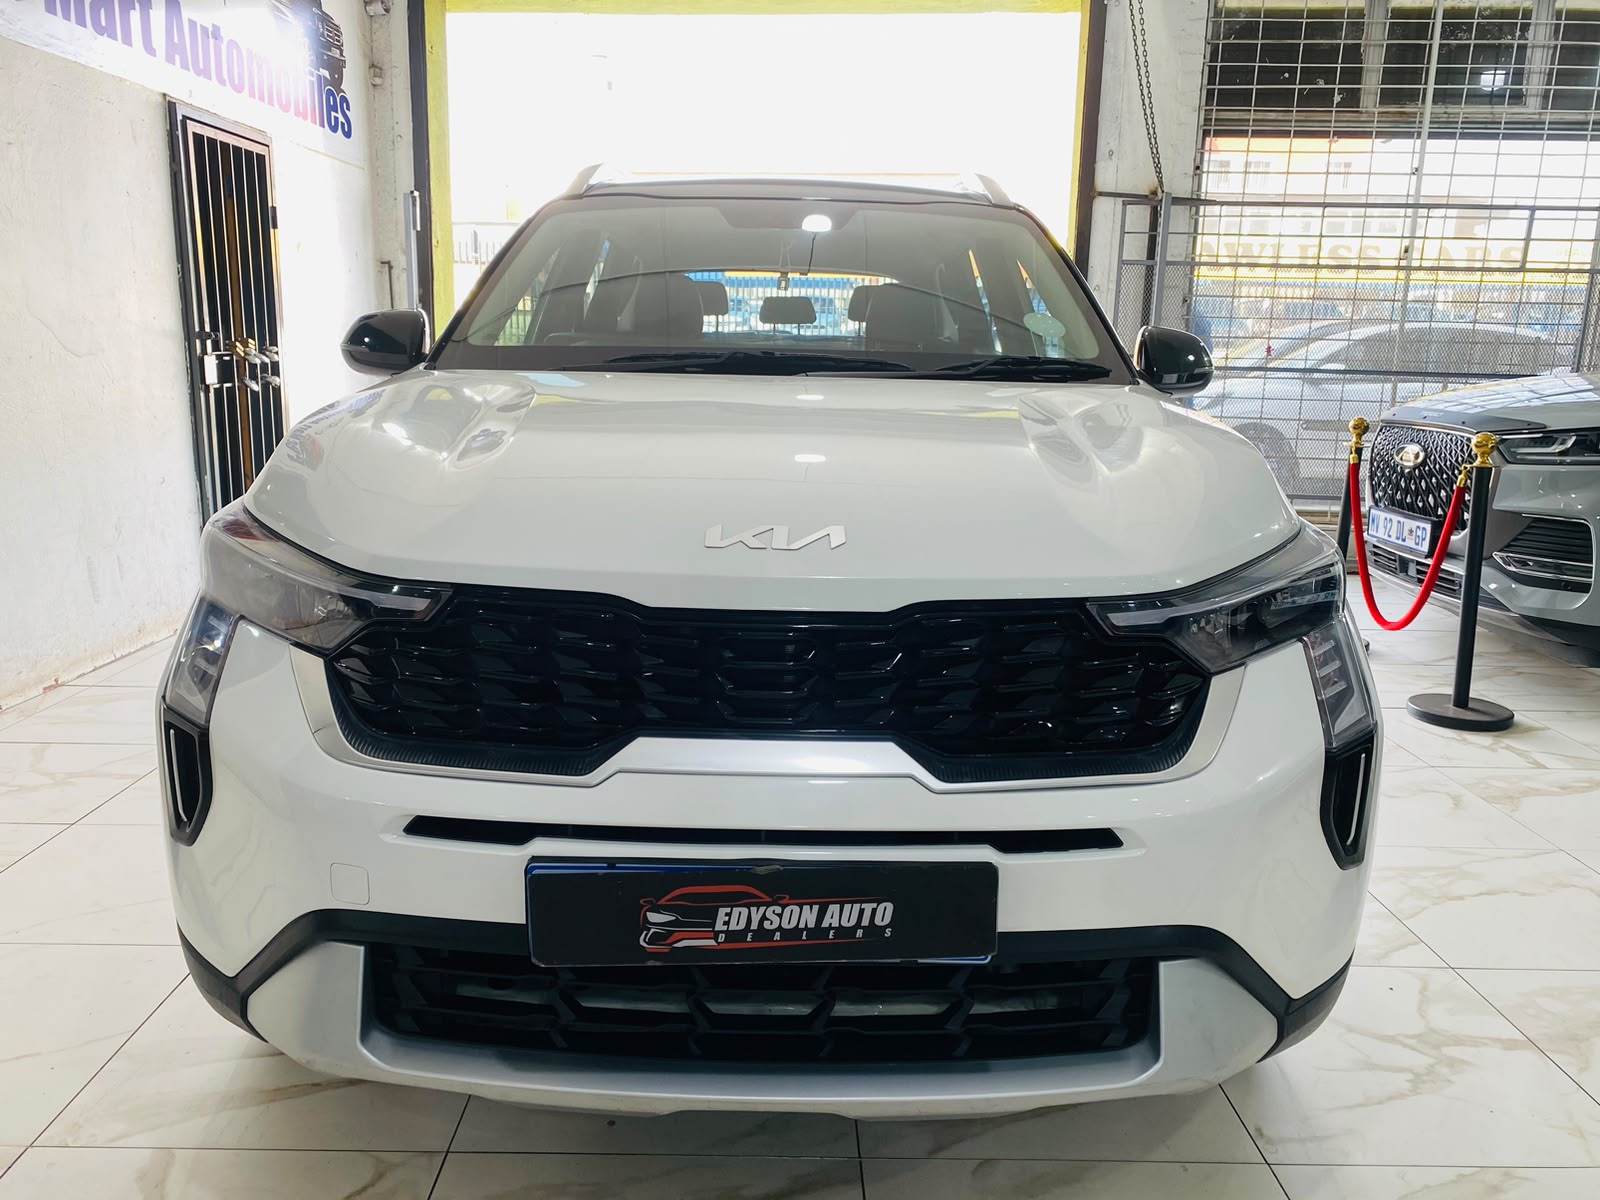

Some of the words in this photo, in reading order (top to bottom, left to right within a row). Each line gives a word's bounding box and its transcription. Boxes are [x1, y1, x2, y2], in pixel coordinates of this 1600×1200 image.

[16, 0, 156, 58] mart
[165, 0, 352, 139] Automobiles
[704, 524, 847, 550] KIA
[1396, 521, 1406, 543] DL
[1414, 525, 1427, 548] GP
[714, 904, 819, 931] EDYSON
[821, 902, 894, 928] AUTO
[717, 928, 892, 942] DEALERS
